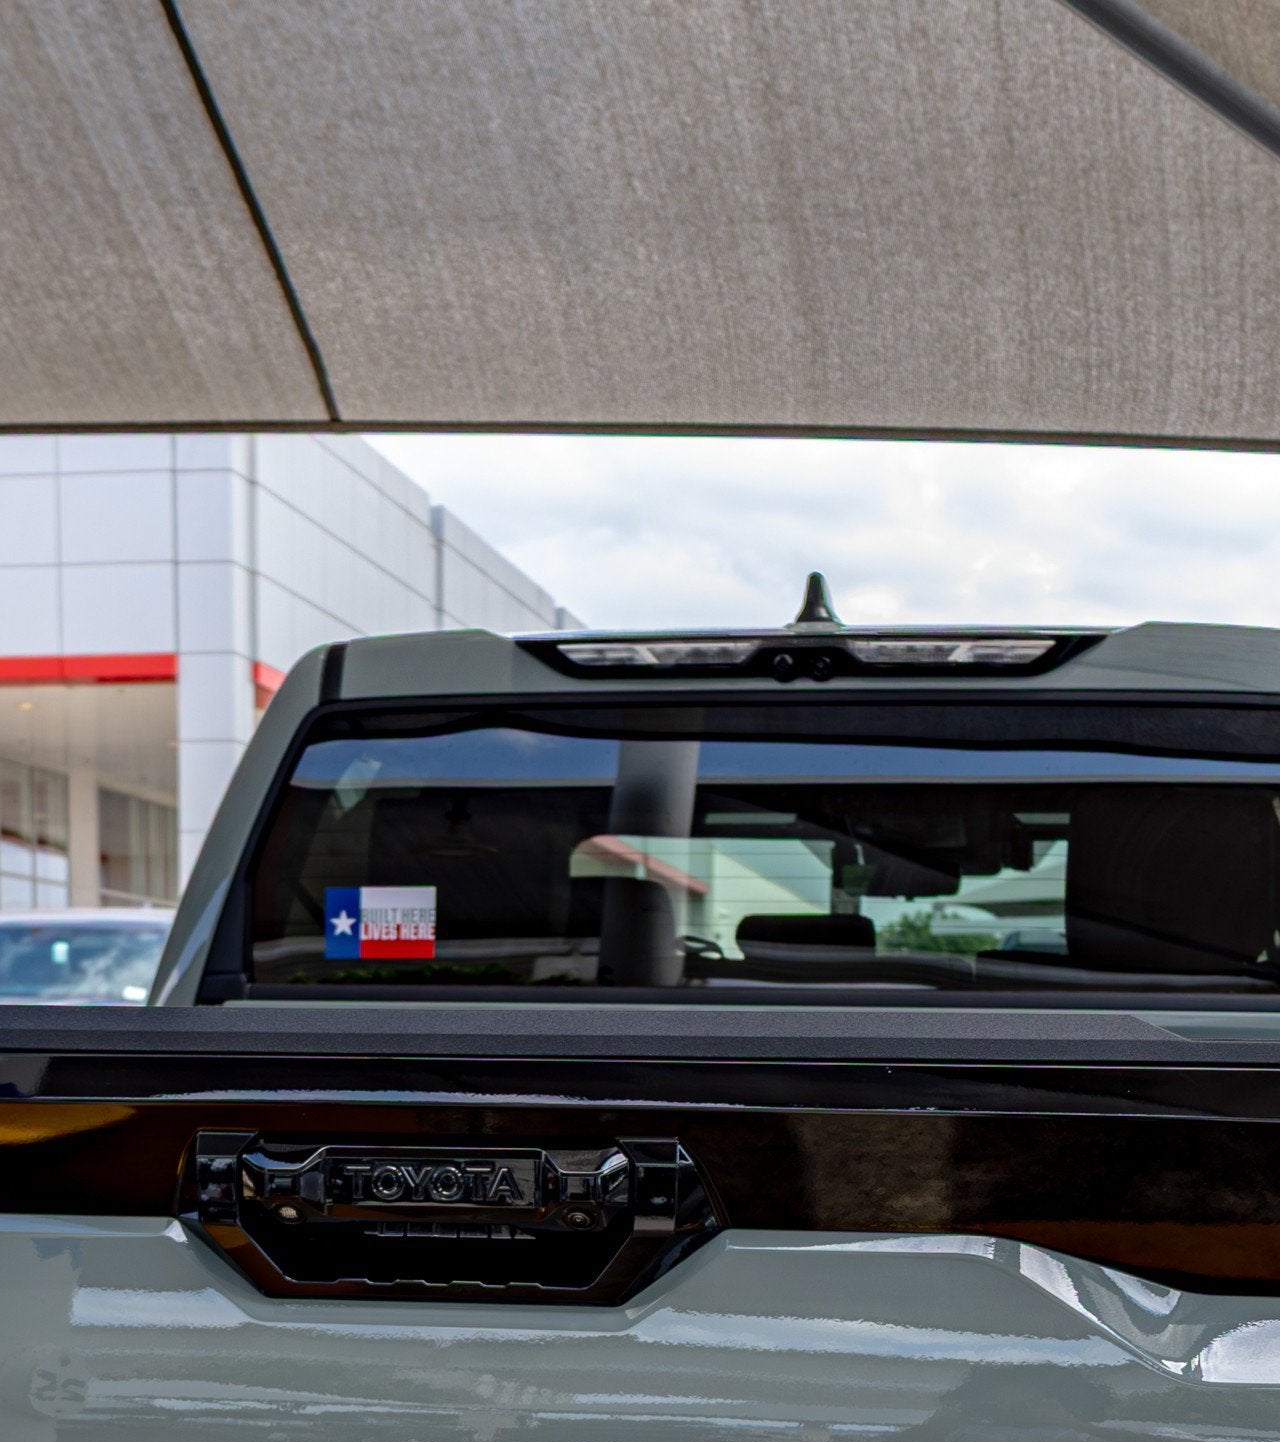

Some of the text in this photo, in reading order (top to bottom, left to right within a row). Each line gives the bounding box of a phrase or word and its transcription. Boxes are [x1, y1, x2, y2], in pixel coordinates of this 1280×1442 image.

[361, 907, 436, 923] BUILT HERE
[361, 923, 436, 940] LIVES HERE
[343, 1164, 524, 1202] TOYOTA
